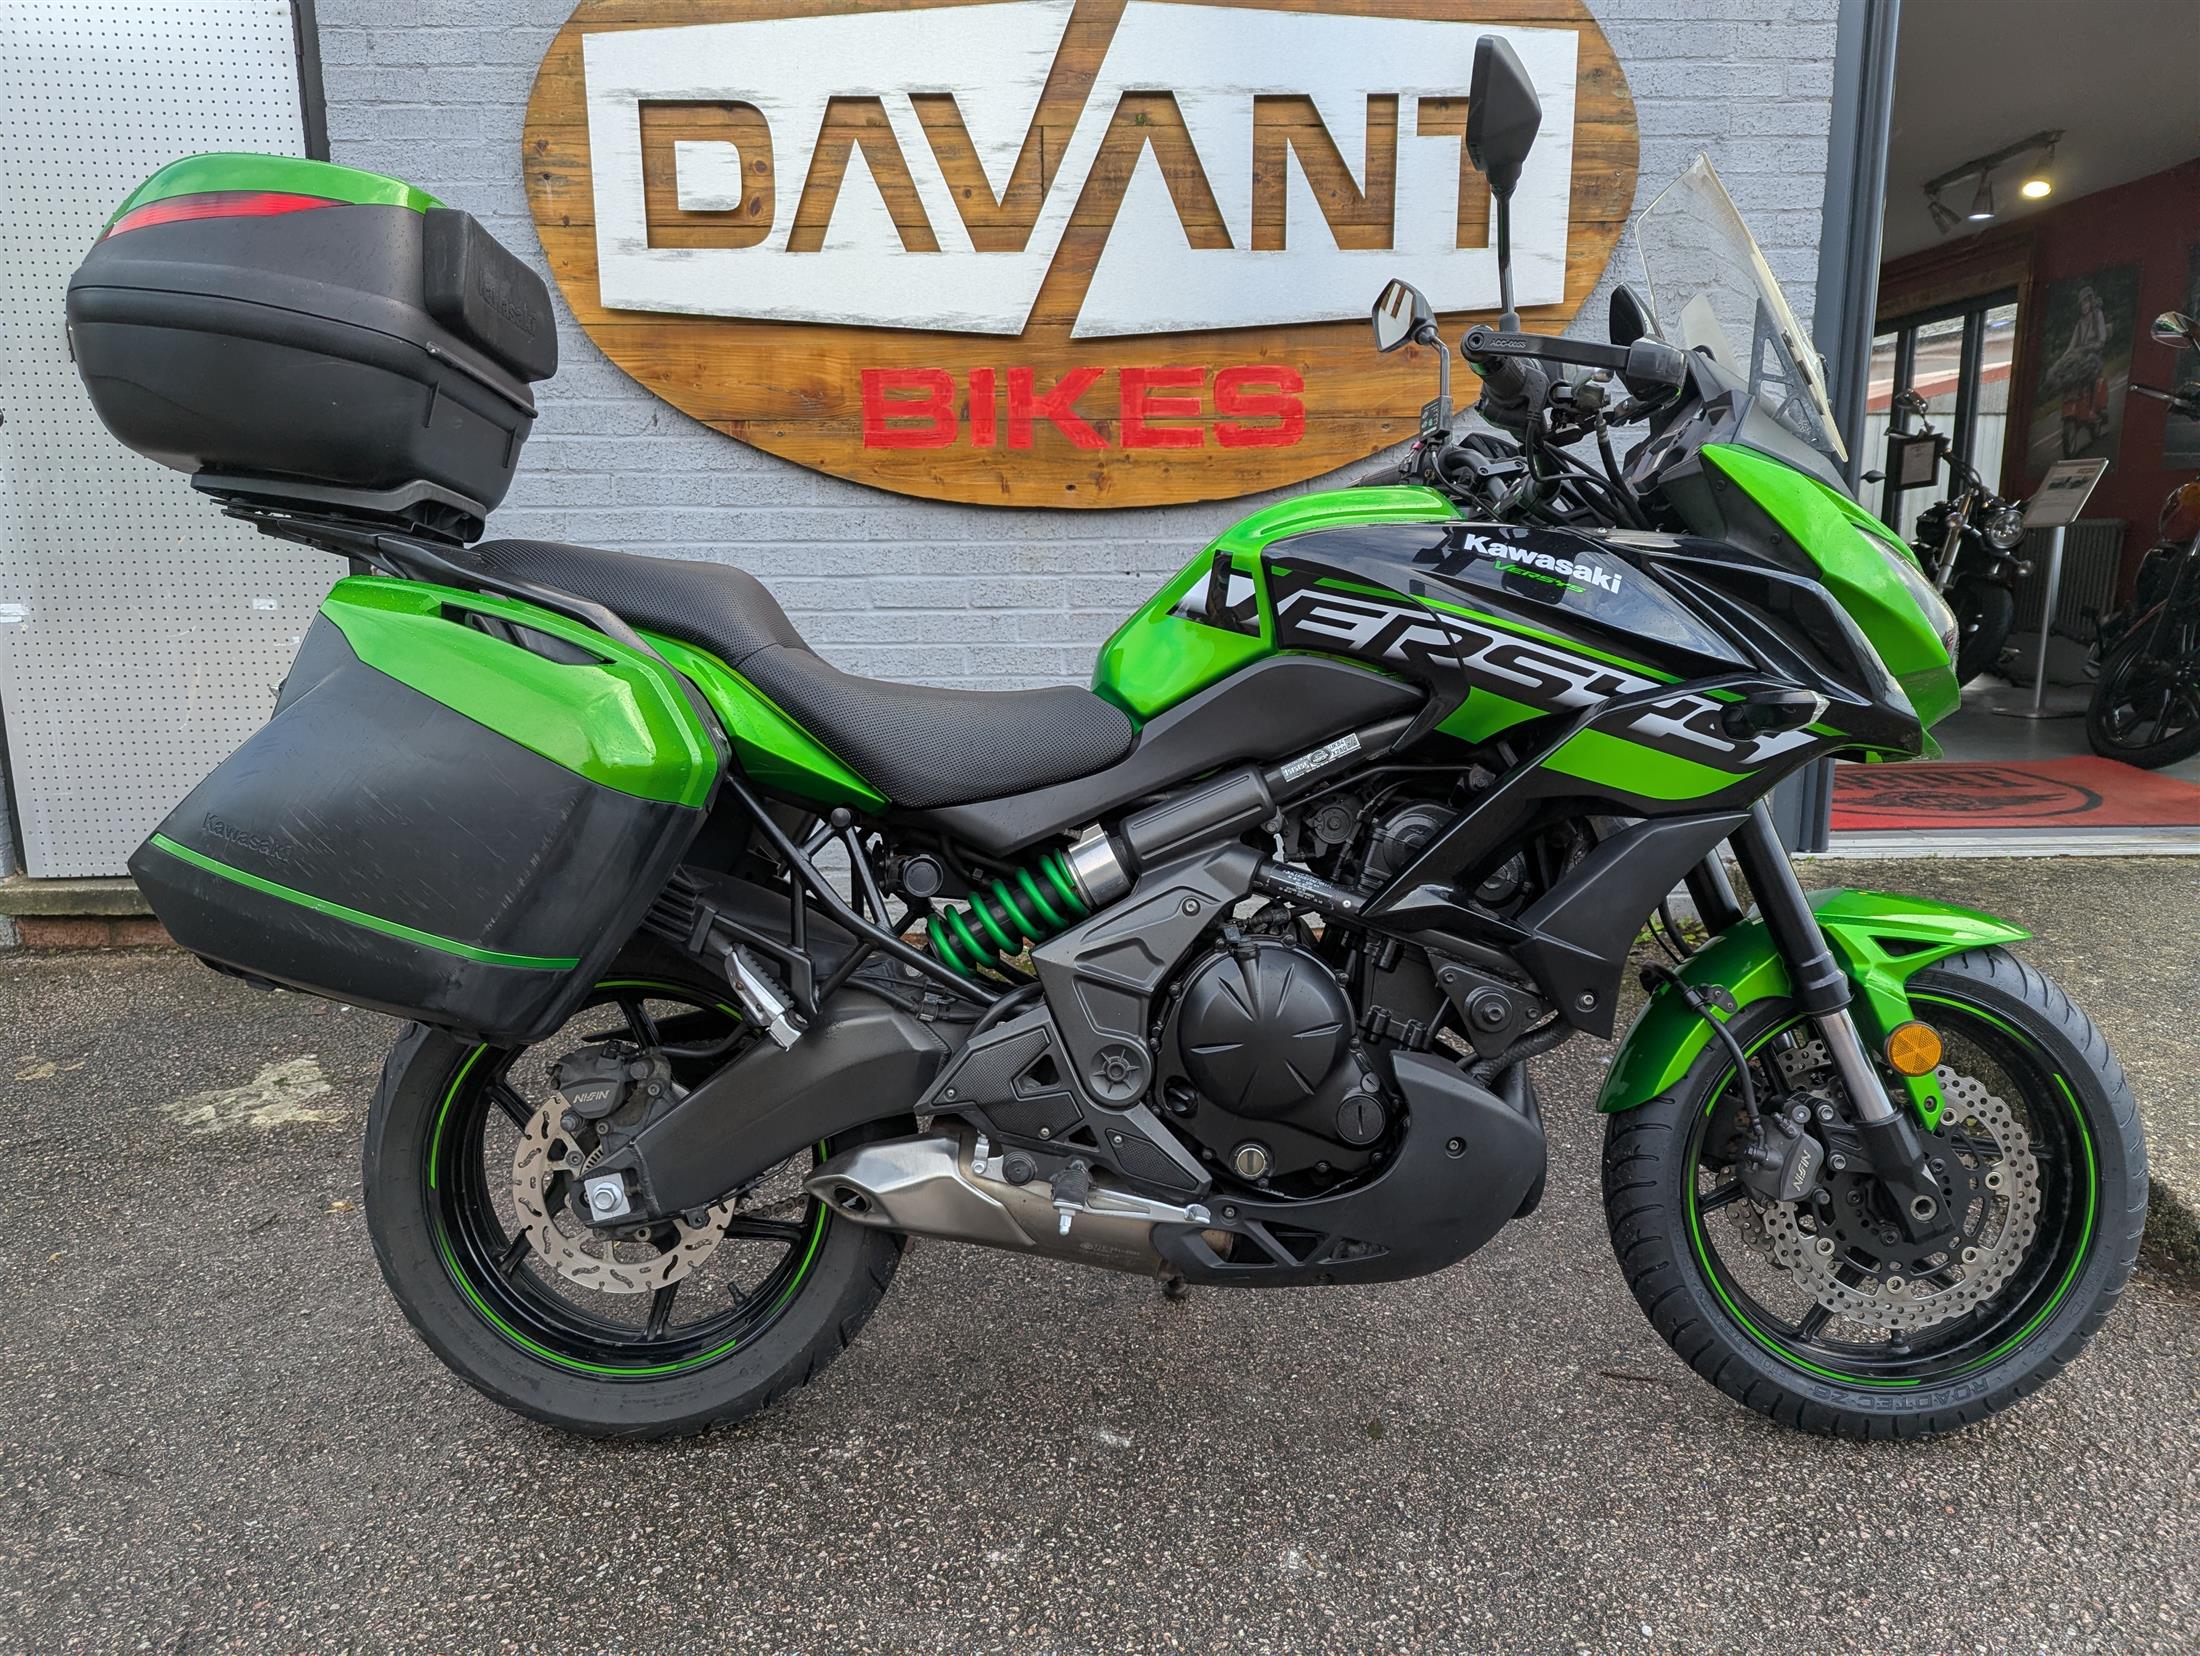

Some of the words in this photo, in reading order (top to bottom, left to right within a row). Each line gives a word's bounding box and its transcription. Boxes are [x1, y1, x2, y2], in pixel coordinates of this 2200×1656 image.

[638, 90, 1494, 253] DAVANT
[861, 365, 1306, 453] BIKES
[1462, 533, 1624, 595] Kawasaki
[1492, 558, 1590, 594] VERSYS
[201, 811, 291, 865] Kawasaki
